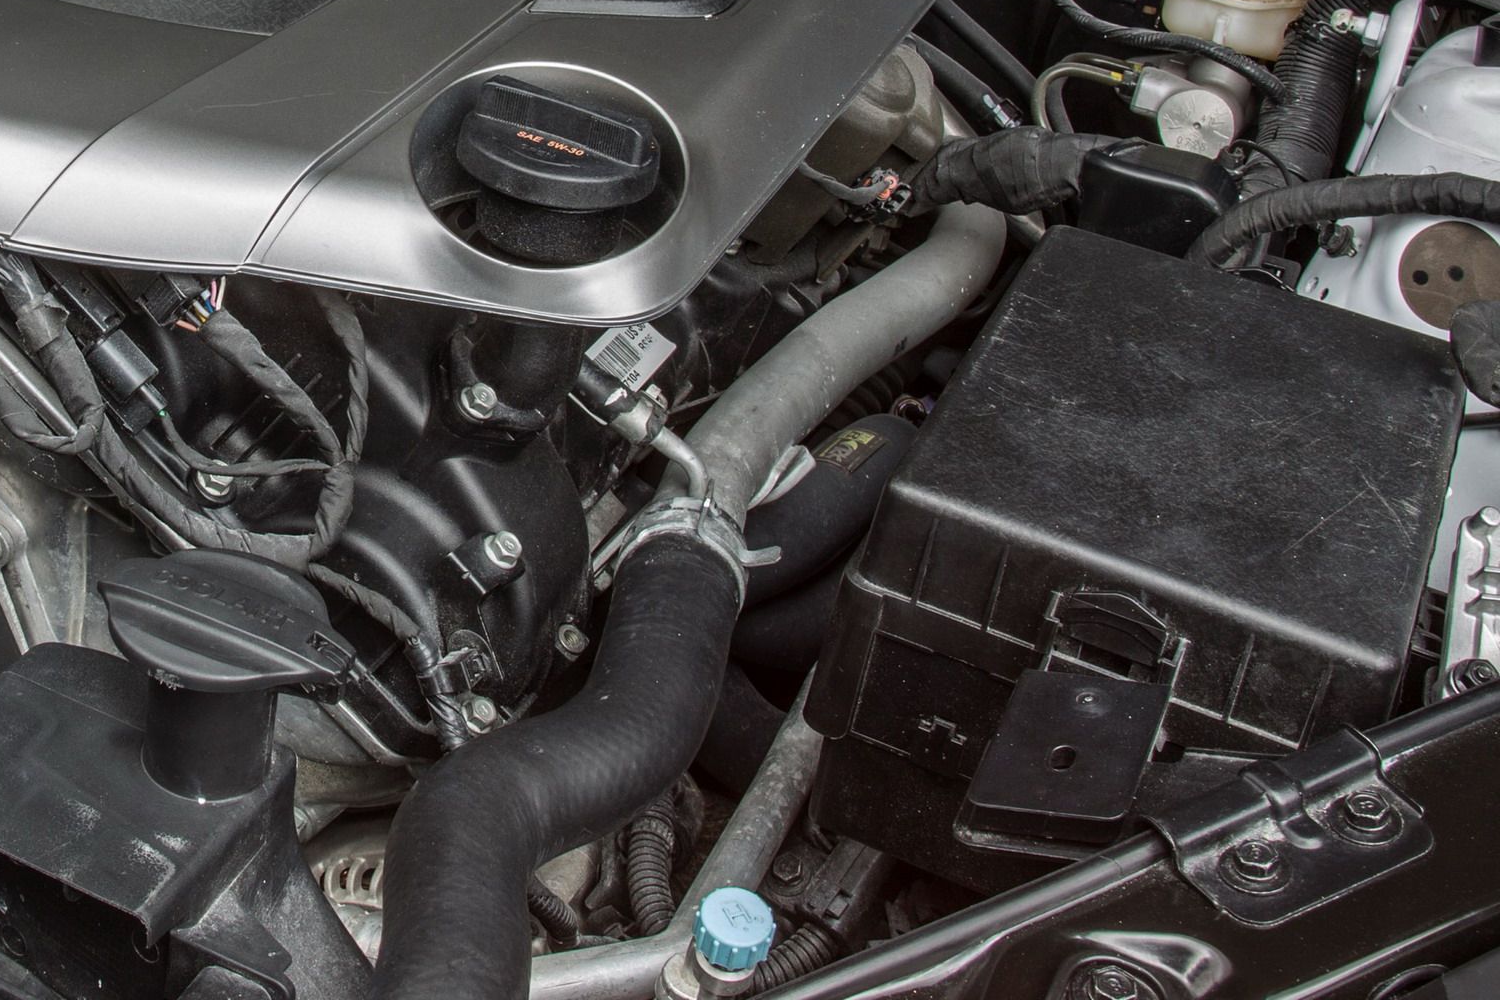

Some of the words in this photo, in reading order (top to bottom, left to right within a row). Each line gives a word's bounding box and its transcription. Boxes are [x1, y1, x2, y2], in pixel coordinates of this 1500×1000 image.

[516, 130, 545, 144] SAE
[547, 140, 585, 157] 5W-30
[625, 325, 639, 340] US
